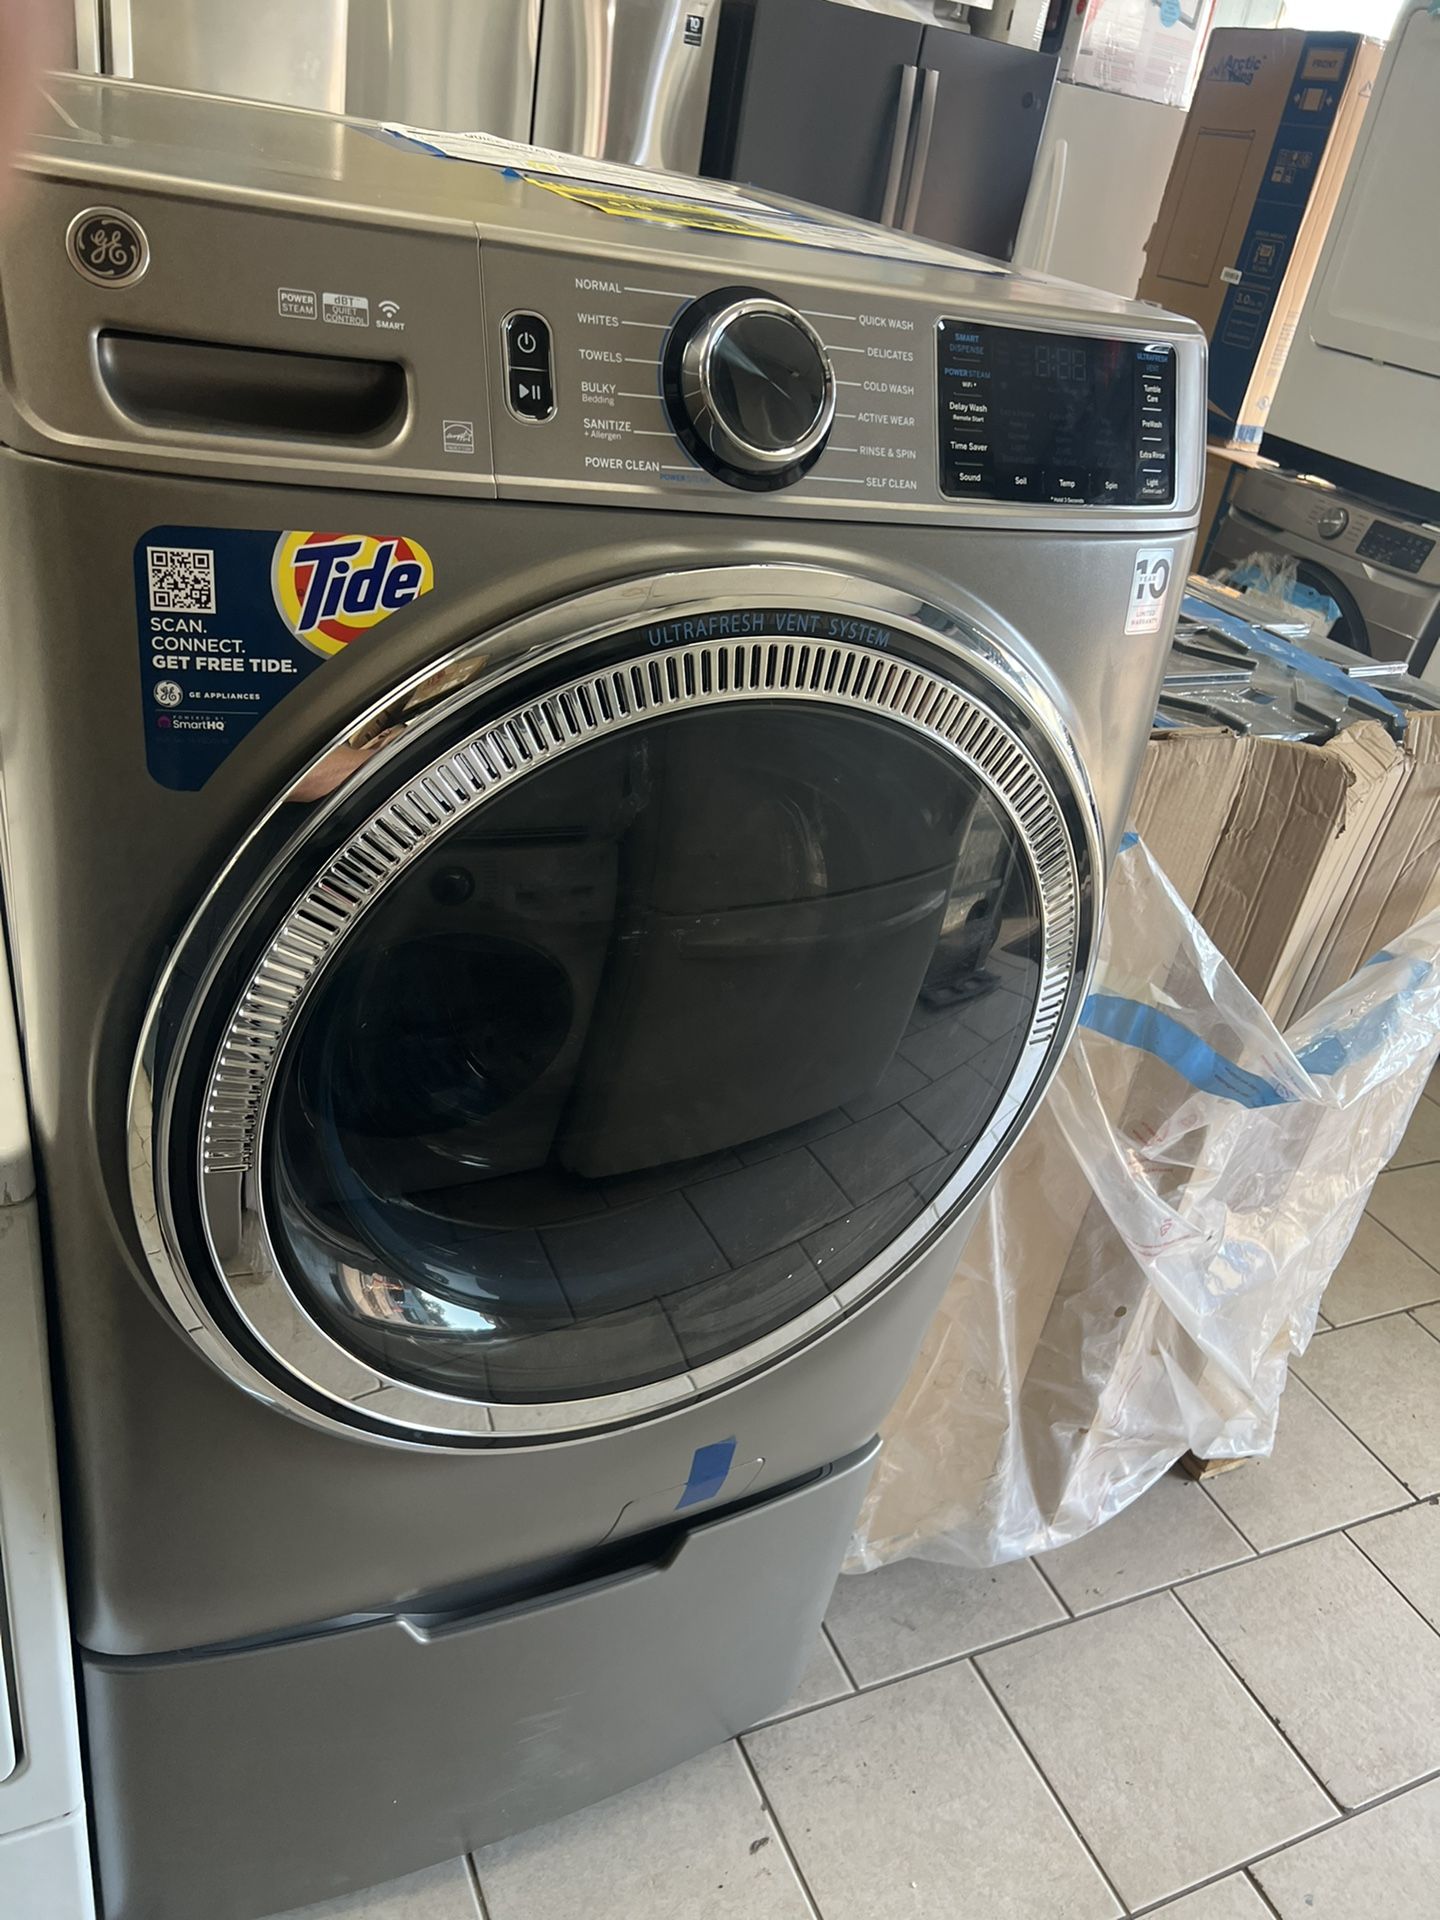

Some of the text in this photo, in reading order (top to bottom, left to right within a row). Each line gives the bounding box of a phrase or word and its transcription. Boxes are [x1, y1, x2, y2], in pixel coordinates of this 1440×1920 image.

[1225, 55, 1261, 71] Arctic
[575, 278, 621, 294] NORMAL
[281, 292, 314, 305] POWER
[334, 296, 354, 306] dBT
[282, 303, 314, 315] STEAM
[332, 306, 356, 316] QUIET
[325, 314, 365, 325] CONTROL
[375, 320, 405, 330] SMART
[577, 312, 619, 327] WHITES
[858, 314, 914, 331] QUICK WASH
[954, 333, 980, 342] SMART
[578, 348, 622, 363] TOWELS
[867, 347, 914, 361] DELICATES
[949, 344, 985, 356] DISPENSE
[581, 381, 616, 393] BULKY
[863, 381, 914, 395] COLD WASH
[582, 394, 614, 406] Bedding
[949, 402, 988, 413] Delay Wash
[858, 412, 916, 427] ACTIVE WEAR
[952, 414, 984, 423] Remote Start
[583, 418, 632, 432] SANITIZE
[591, 430, 621, 441] Allergen
[860, 446, 917, 459] RINSE & SPIN
[950, 441, 988, 452] Time Saver
[585, 457, 660, 471] POWER CLEAN
[959, 472, 981, 482] Sound
[1015, 476, 1027, 485] Soil
[866, 477, 917, 490] SELF CLEAN
[1059, 479, 1075, 488] Temp
[1105, 481, 1118, 490] Spin
[1146, 479, 1158, 488] Light
[1136, 559, 1170, 600] 10
[293, 541, 424, 634] Tide
[150, 617, 207, 633] SCAN.
[648, 613, 891, 648] ULTRAFRESH VENT SYSTEM
[151, 636, 246, 653] CONNECT.
[152, 655, 298, 673] GET FREE TIDE.
[188, 691, 261, 700] GE APPLIANCES
[172, 719, 225, 731] SmartHQ
